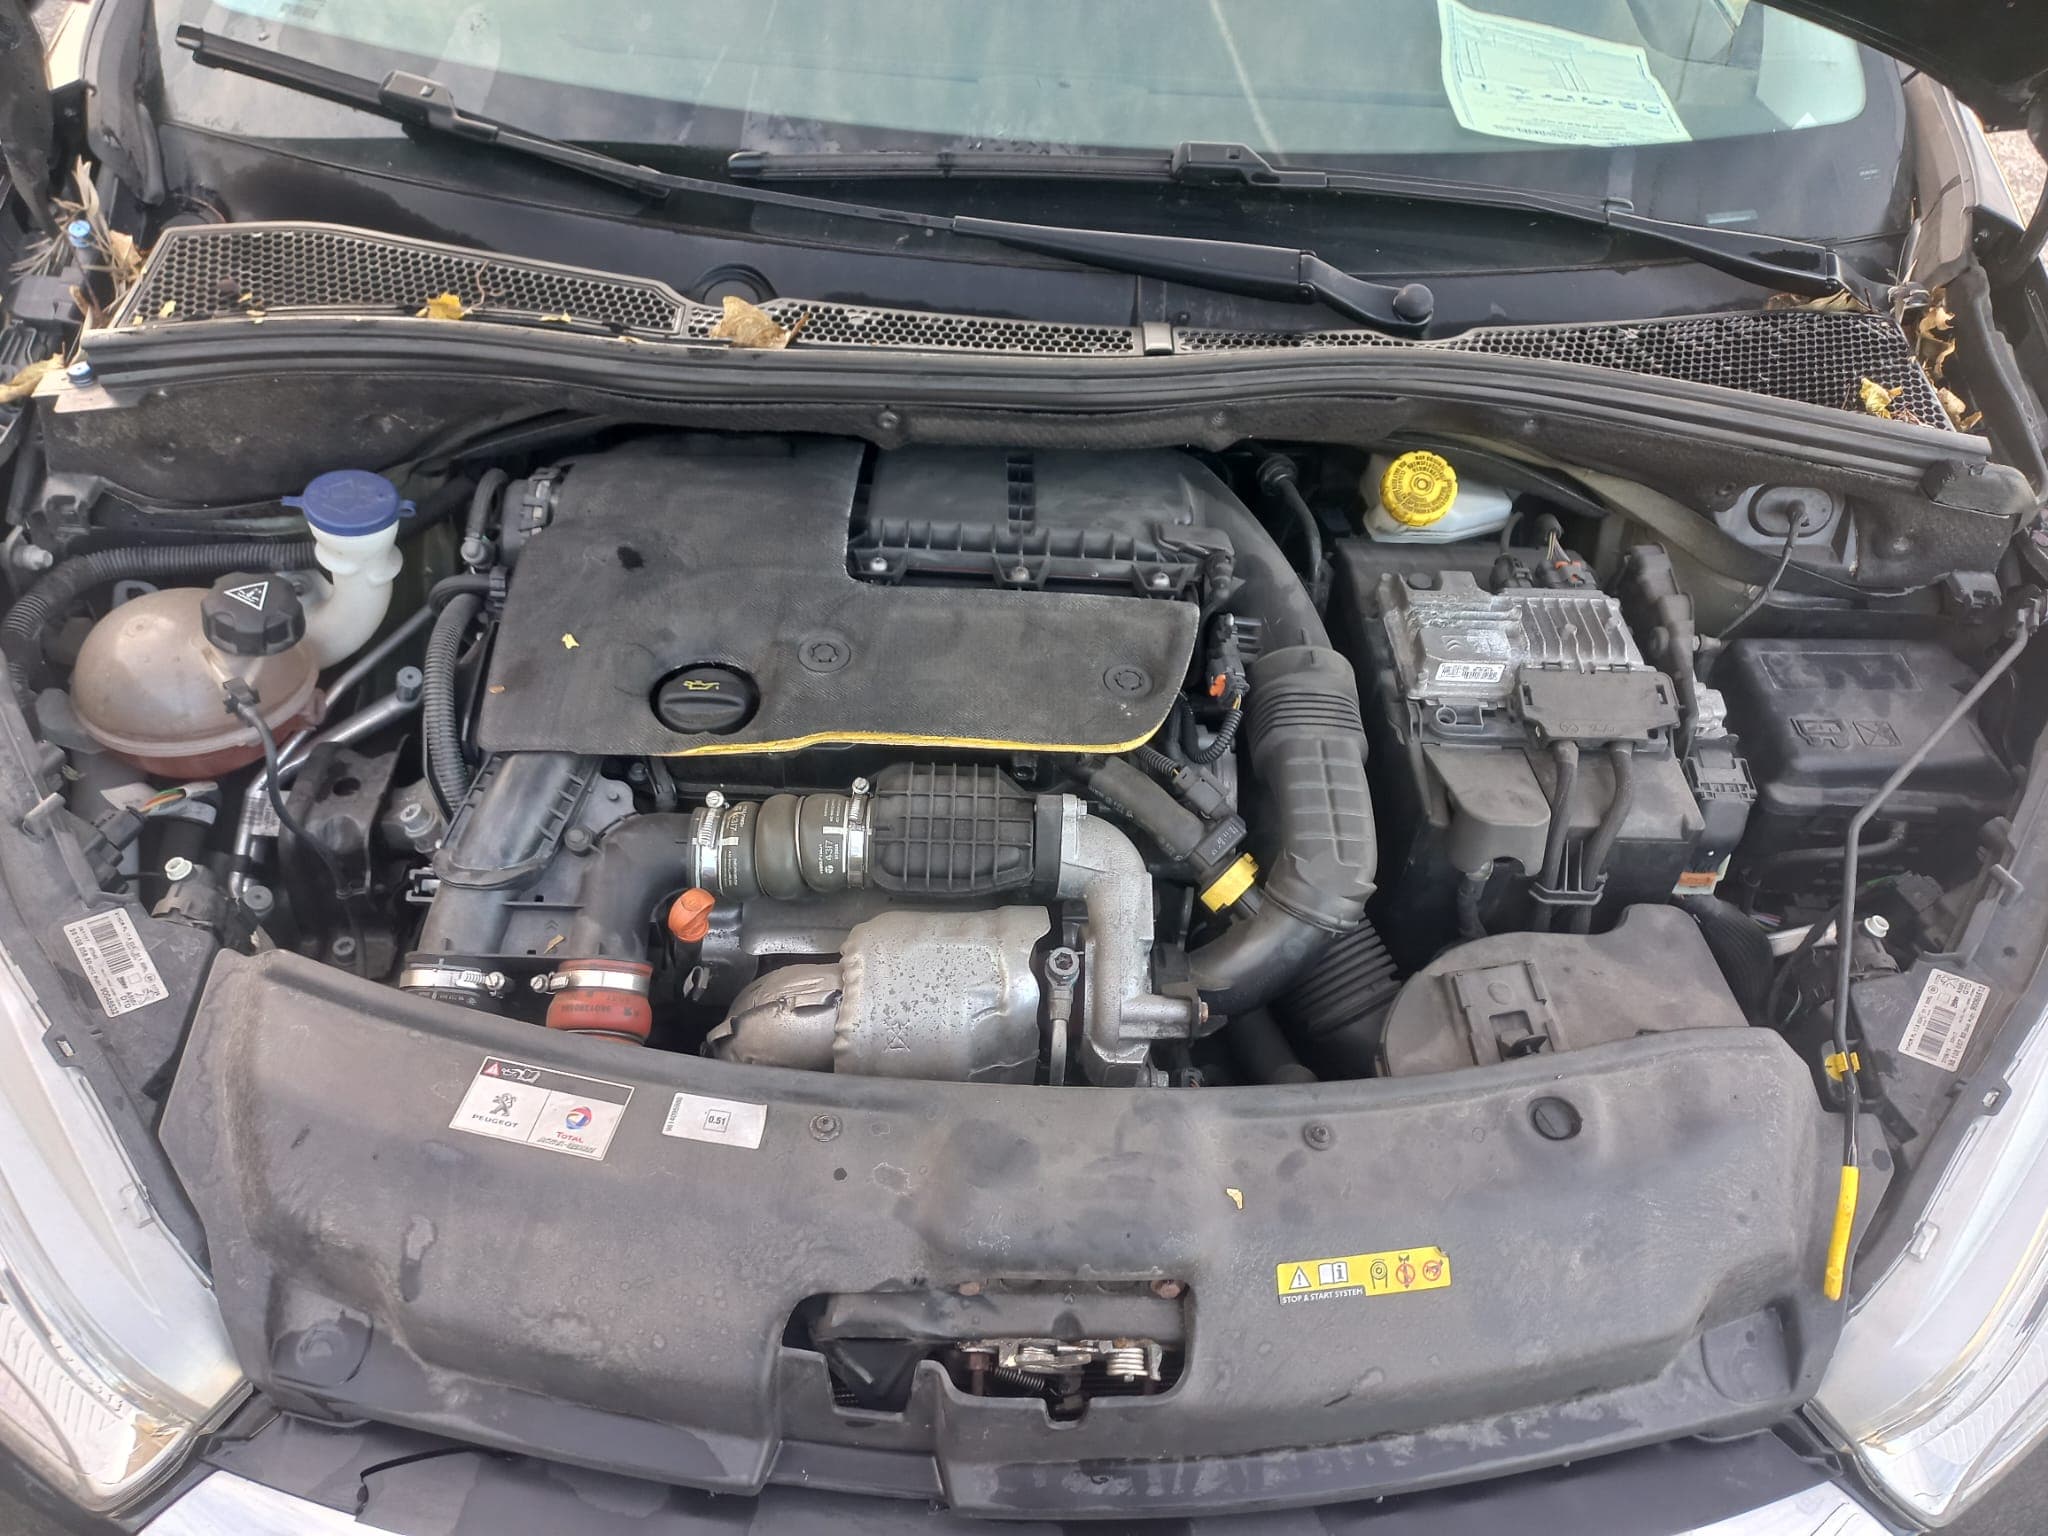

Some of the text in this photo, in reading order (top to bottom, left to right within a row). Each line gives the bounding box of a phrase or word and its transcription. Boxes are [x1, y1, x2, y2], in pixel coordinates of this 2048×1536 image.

[471, 1113, 519, 1128] PEUGEOT
[708, 1115, 727, 1126] 0.51
[556, 1131, 584, 1144] TOTAL
[1282, 1294, 1303, 1304] STOP
[1310, 1290, 1333, 1301] START
[1334, 1287, 1363, 1298] SYSTEM
